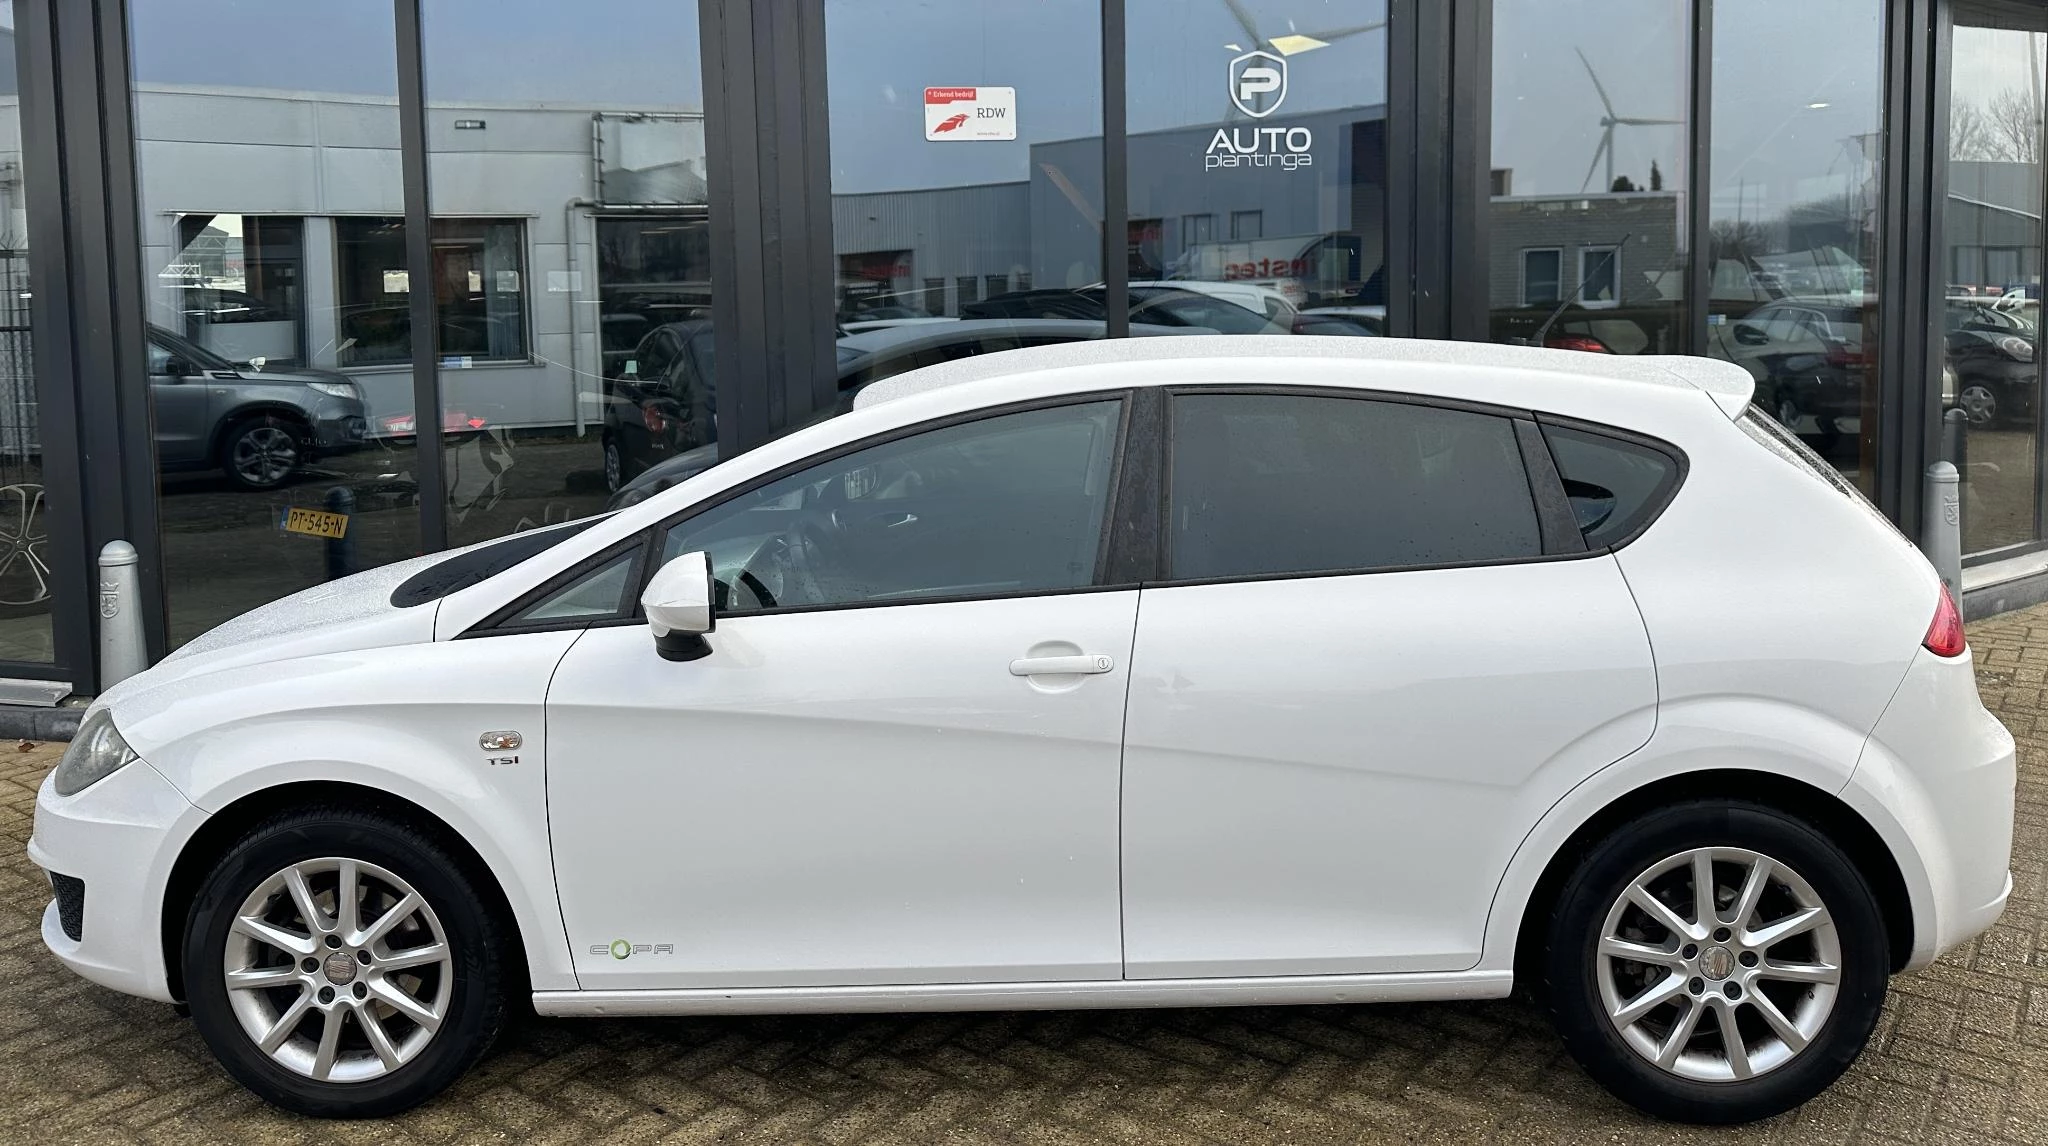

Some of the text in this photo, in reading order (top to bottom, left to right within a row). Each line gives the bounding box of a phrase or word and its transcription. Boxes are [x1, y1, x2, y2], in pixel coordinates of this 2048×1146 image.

[1240, 67, 1281, 100] P
[977, 108, 1006, 118] RDW
[1206, 127, 1312, 154] AUTO
[1205, 152, 1313, 172] plantinga
[290, 511, 343, 535] PT-545-N
[589, 939, 674, 960] COPA
